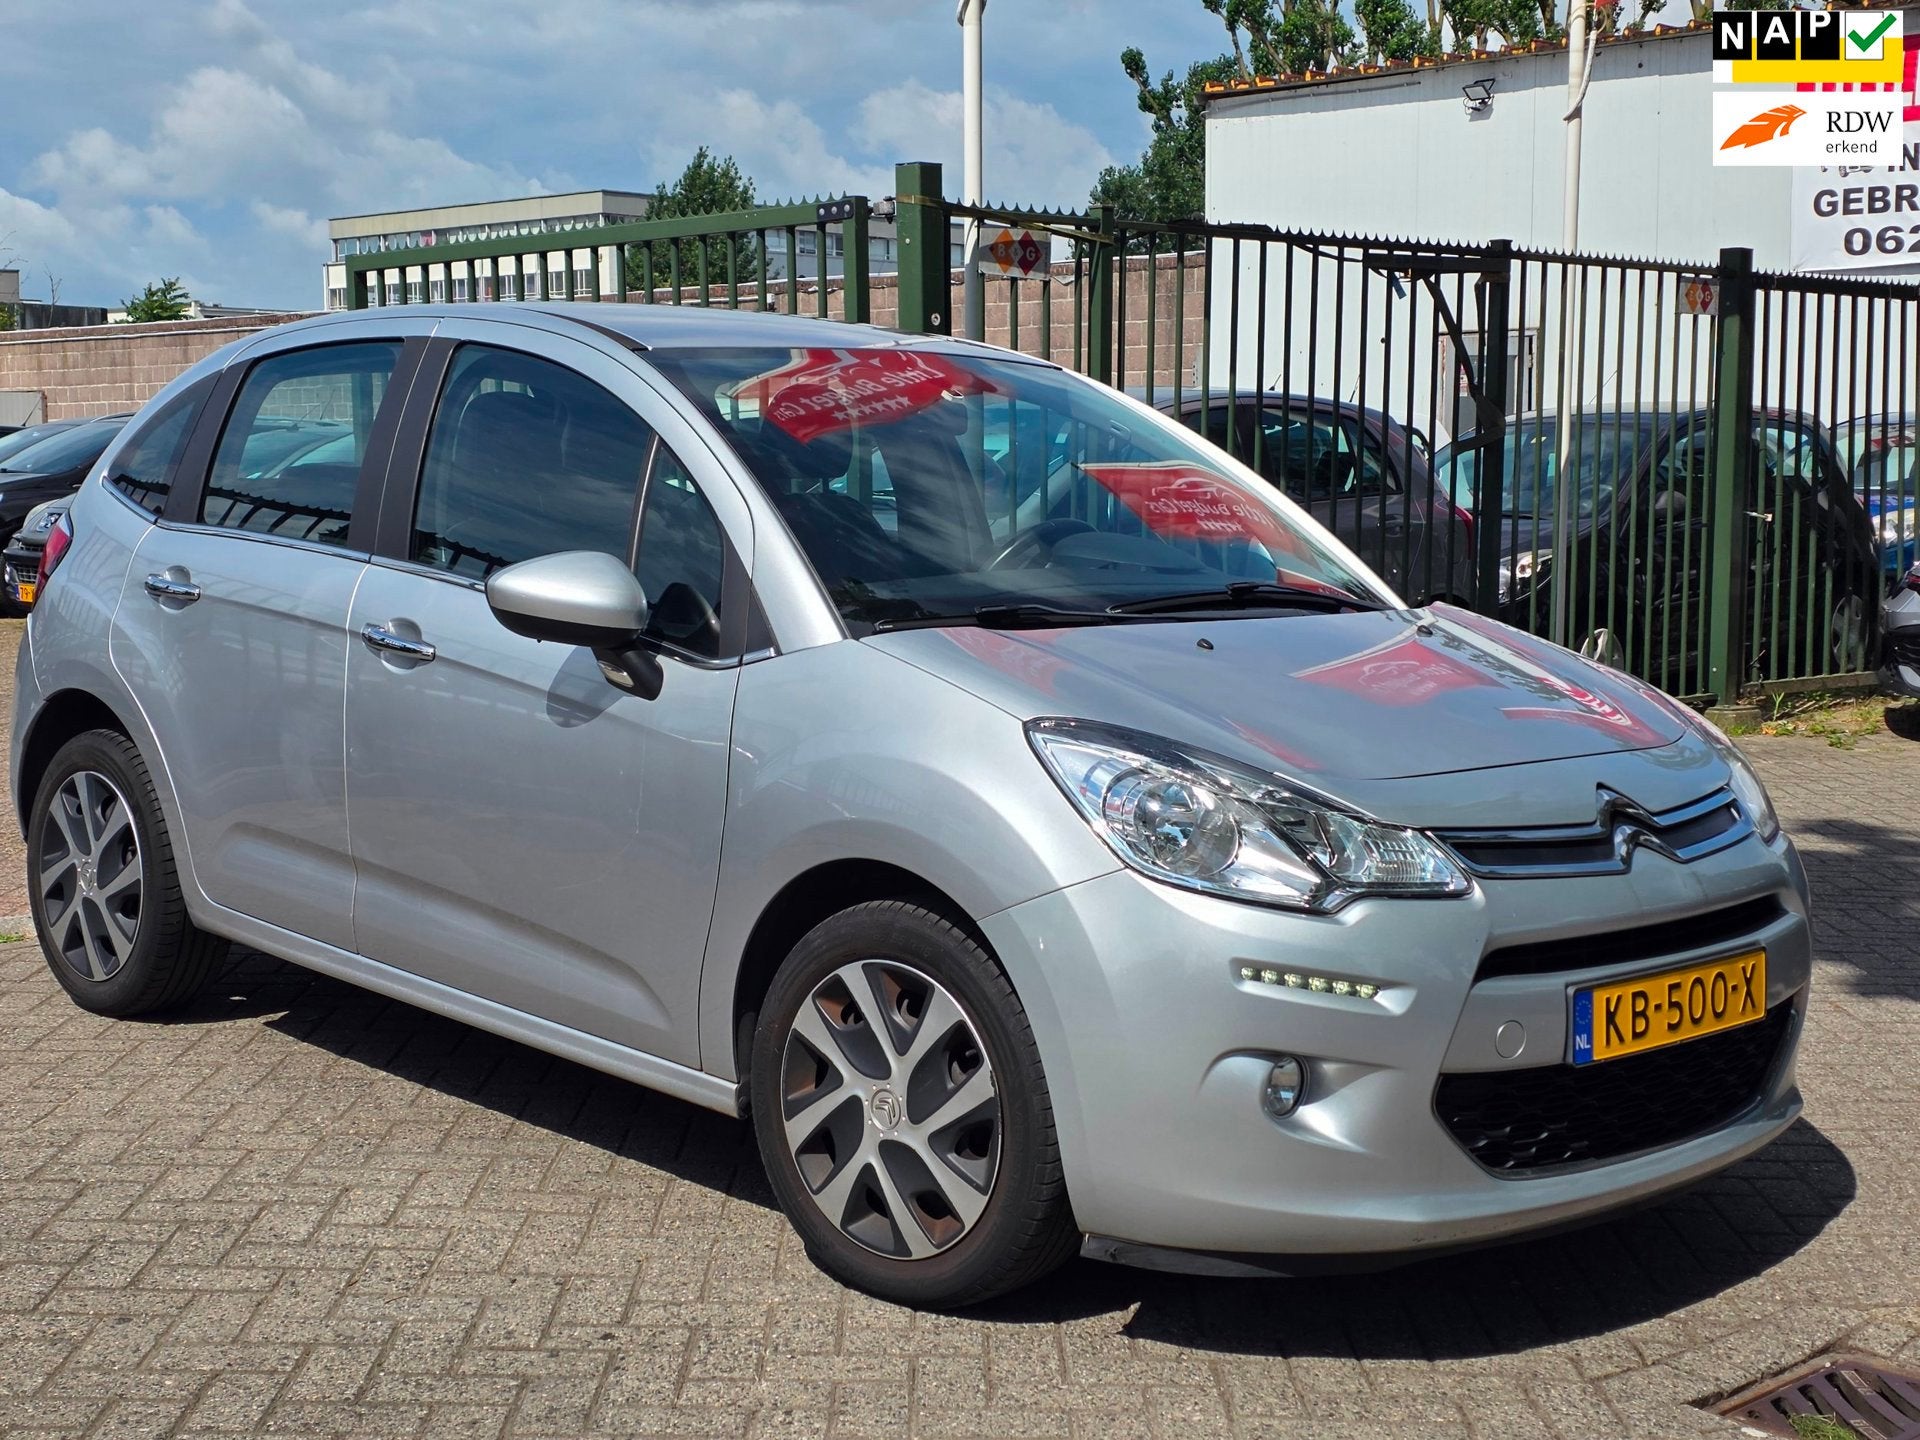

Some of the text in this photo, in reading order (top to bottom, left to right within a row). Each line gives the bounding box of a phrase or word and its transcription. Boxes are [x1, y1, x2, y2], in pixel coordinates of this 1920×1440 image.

[1813, 184, 1920, 217] GEBR
[1604, 961, 1756, 1047] KB-500-X
[1575, 1034, 1591, 1050] NL
